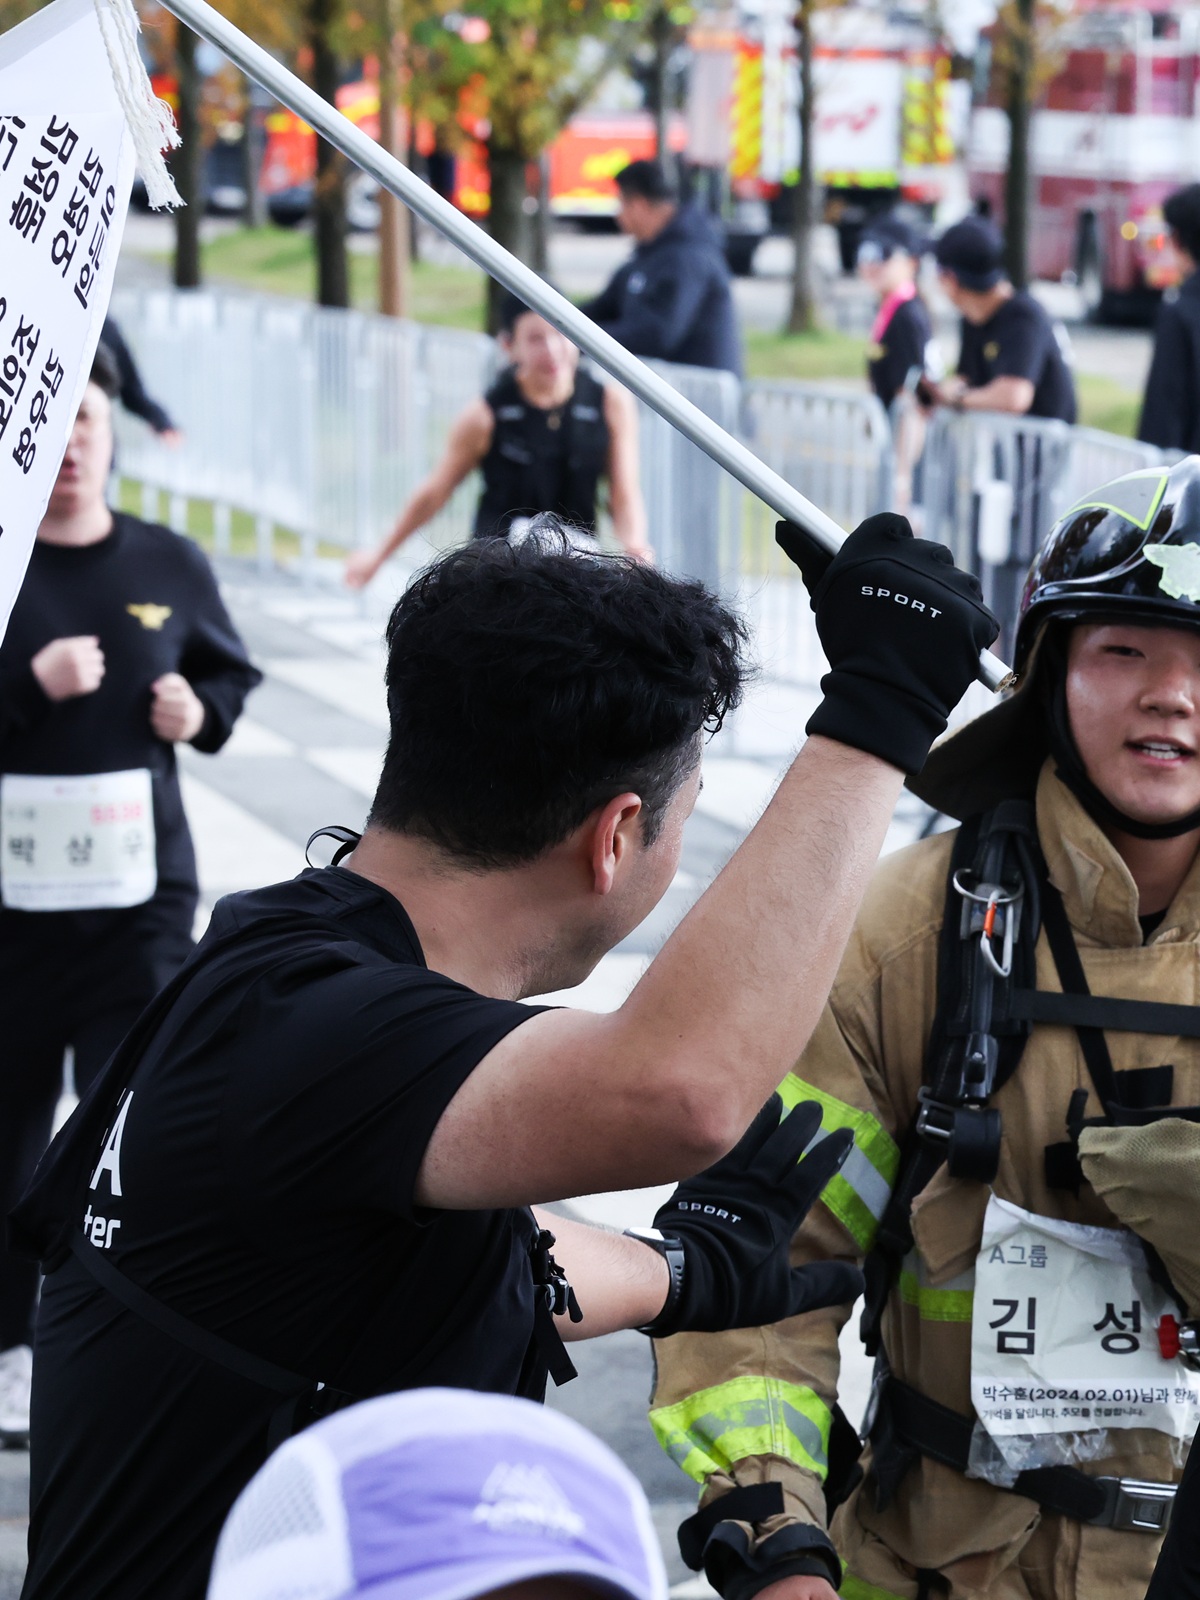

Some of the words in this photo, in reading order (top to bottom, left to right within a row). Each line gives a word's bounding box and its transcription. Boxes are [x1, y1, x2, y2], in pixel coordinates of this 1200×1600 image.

[861, 585, 942, 619] SPORT
[678, 1201, 742, 1223] SPORT
[988, 1245, 1048, 1269] A그룹
[989, 1297, 1037, 1355] 김
[1093, 1300, 1142, 1355] 성
